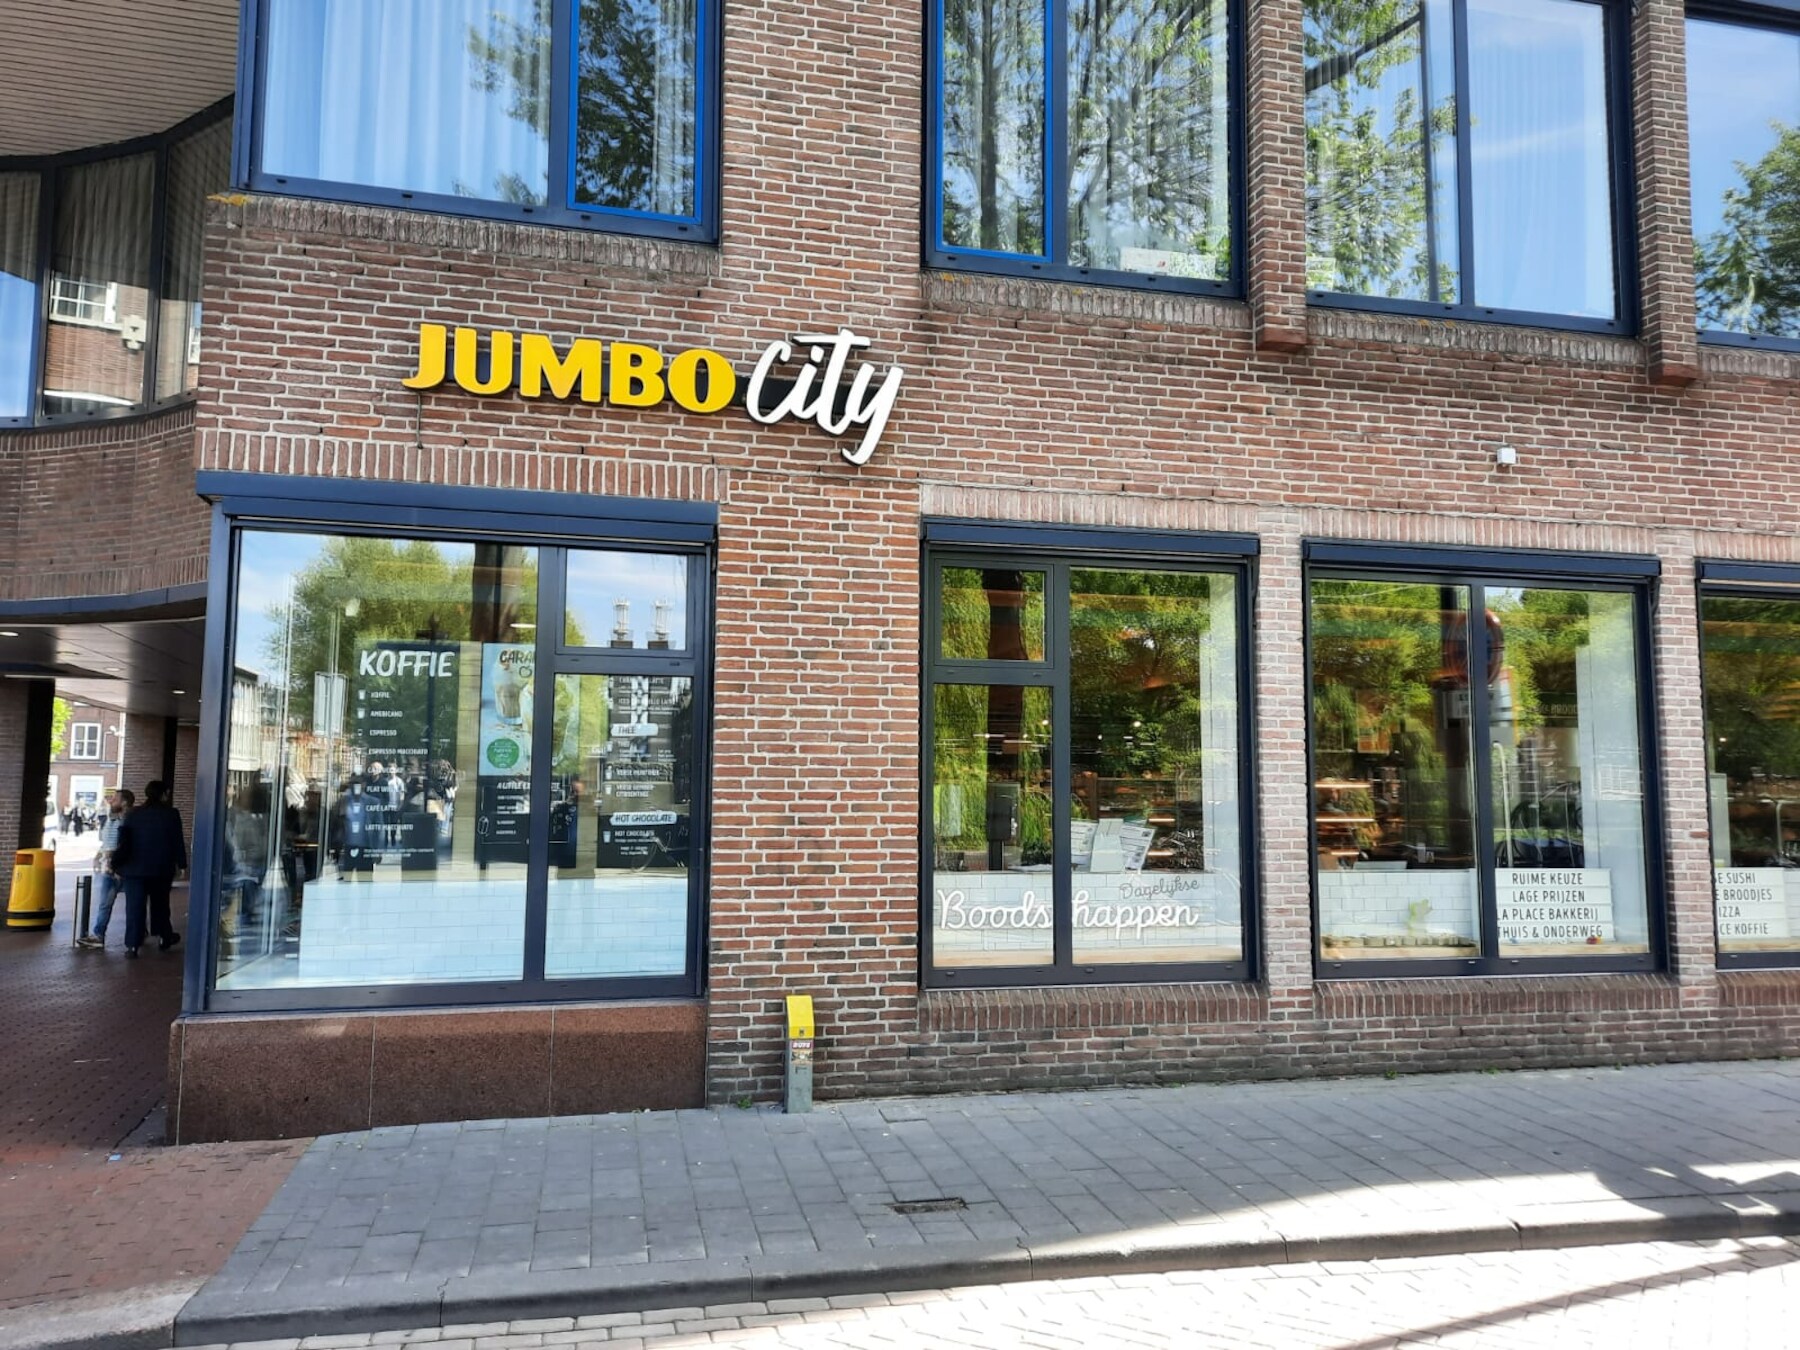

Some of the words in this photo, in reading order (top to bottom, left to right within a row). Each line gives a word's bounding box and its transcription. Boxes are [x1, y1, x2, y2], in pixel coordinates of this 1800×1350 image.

[402, 323, 737, 412] JUMBO
[359, 650, 455, 677] KOFFIE
[500, 650, 534, 664] CARA
[370, 710, 403, 718] AMERICANO
[369, 729, 397, 737] ESPRESSO
[615, 814, 629, 823] HOT
[632, 813, 672, 823] CHOCOLATE
[1512, 872, 1546, 885] RUIME
[1550, 872, 1584, 885] KEUZE
[1726, 872, 1756, 884] SUSHI
[1513, 890, 1539, 903] LAGE
[1542, 890, 1585, 904] PRIJZEN
[1723, 888, 1773, 902] BROODJES
[1512, 908, 1545, 921] PLACE
[1549, 908, 1598, 921] BAKKERIJ
[1718, 905, 1741, 918] IZZA
[1543, 925, 1603, 938] ONDERWEG
[1734, 922, 1768, 935] KOFFIE
